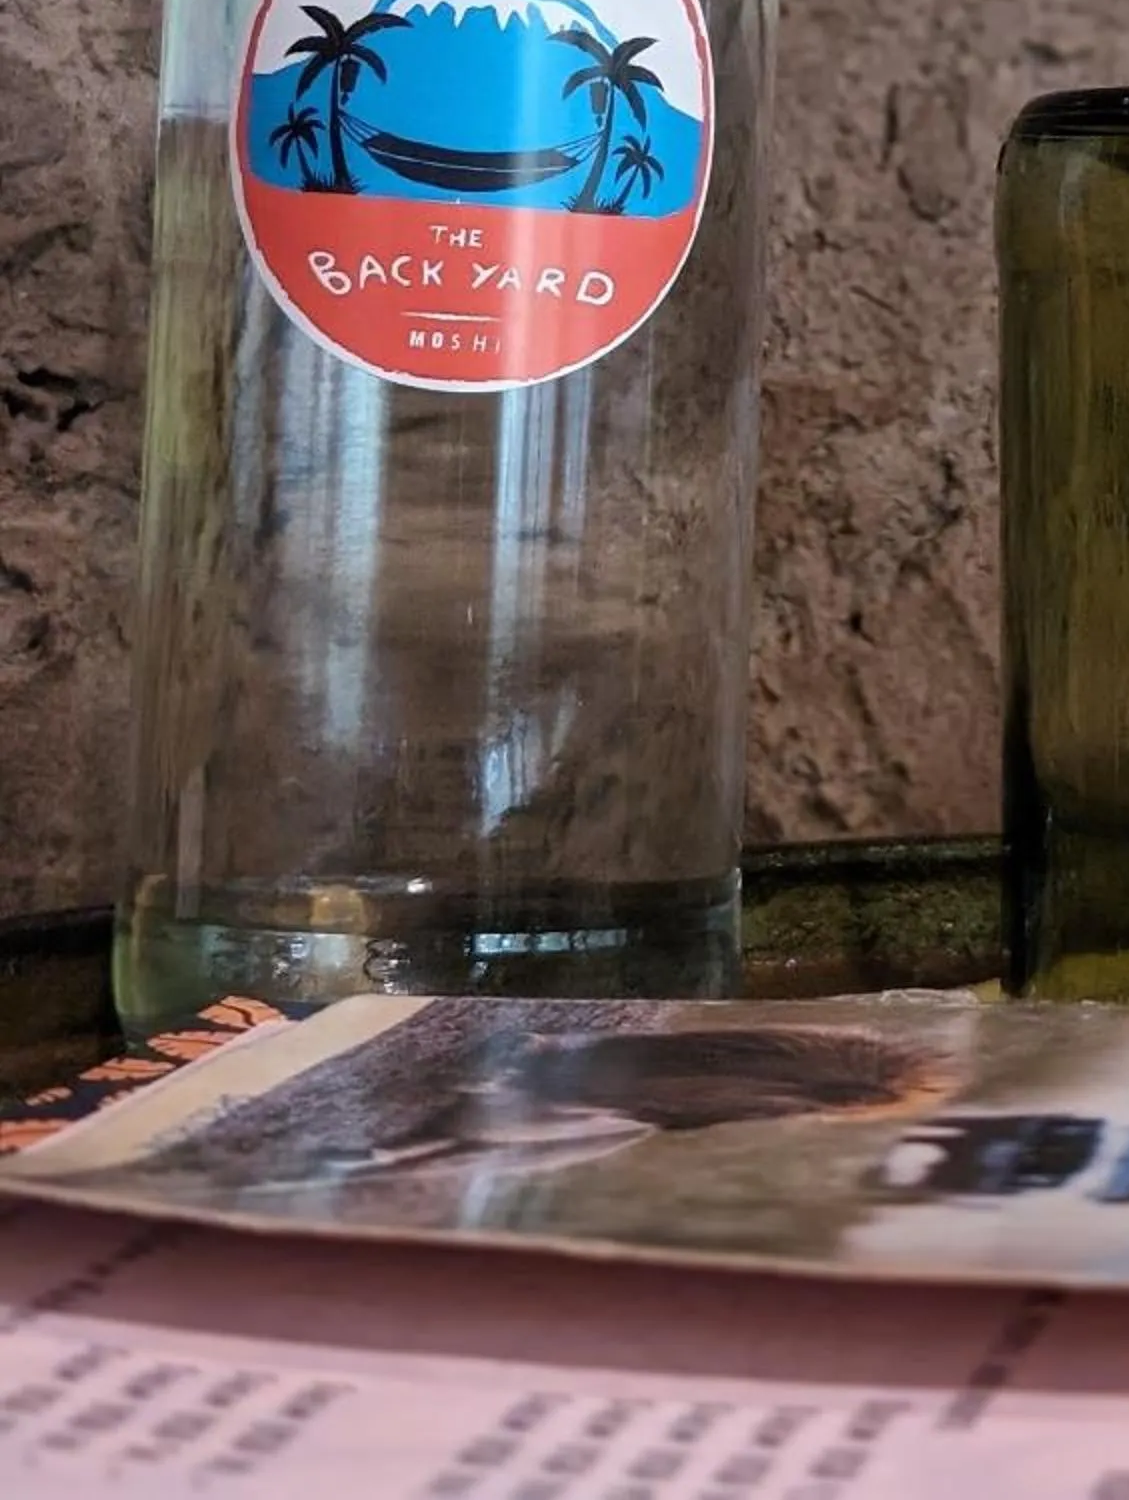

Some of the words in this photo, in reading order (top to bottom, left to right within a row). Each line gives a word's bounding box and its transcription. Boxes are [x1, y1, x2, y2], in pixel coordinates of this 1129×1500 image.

[428, 225, 483, 248] THE
[307, 251, 444, 295] BACK
[471, 262, 614, 305] YARD
[408, 331, 502, 355] MOSHI
